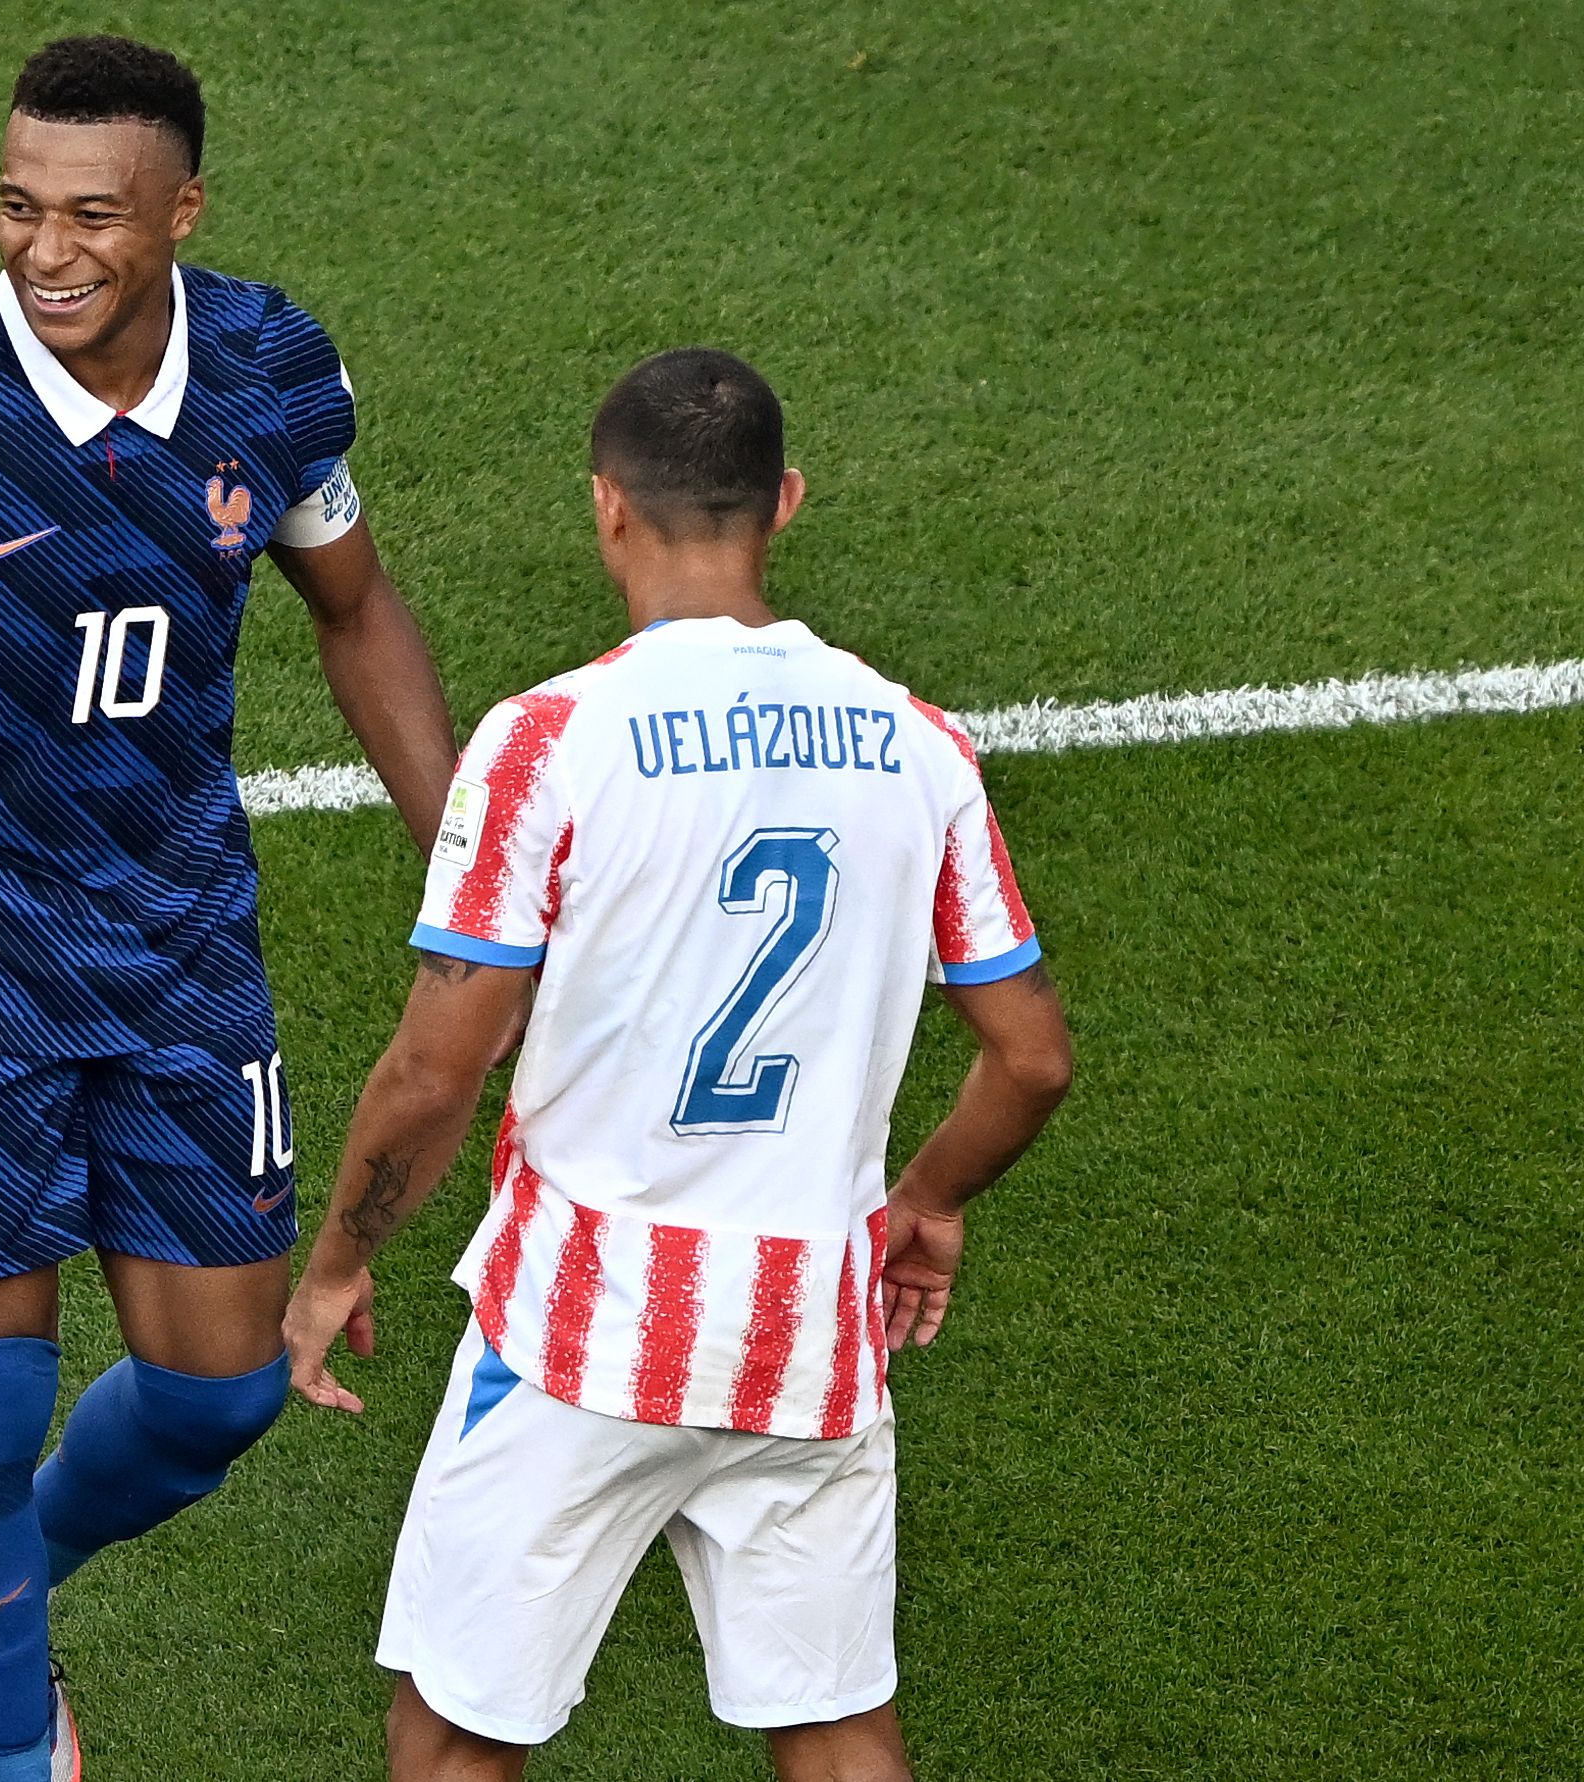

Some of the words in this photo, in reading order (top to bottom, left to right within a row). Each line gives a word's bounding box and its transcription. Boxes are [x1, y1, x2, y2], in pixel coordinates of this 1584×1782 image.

[71, 605, 170, 724] 10
[733, 645, 787, 660] PARAGUAY
[628, 691, 903, 778] VELÁZQUEZ
[669, 826, 840, 1138] 2
[241, 1050, 294, 1178] 10
